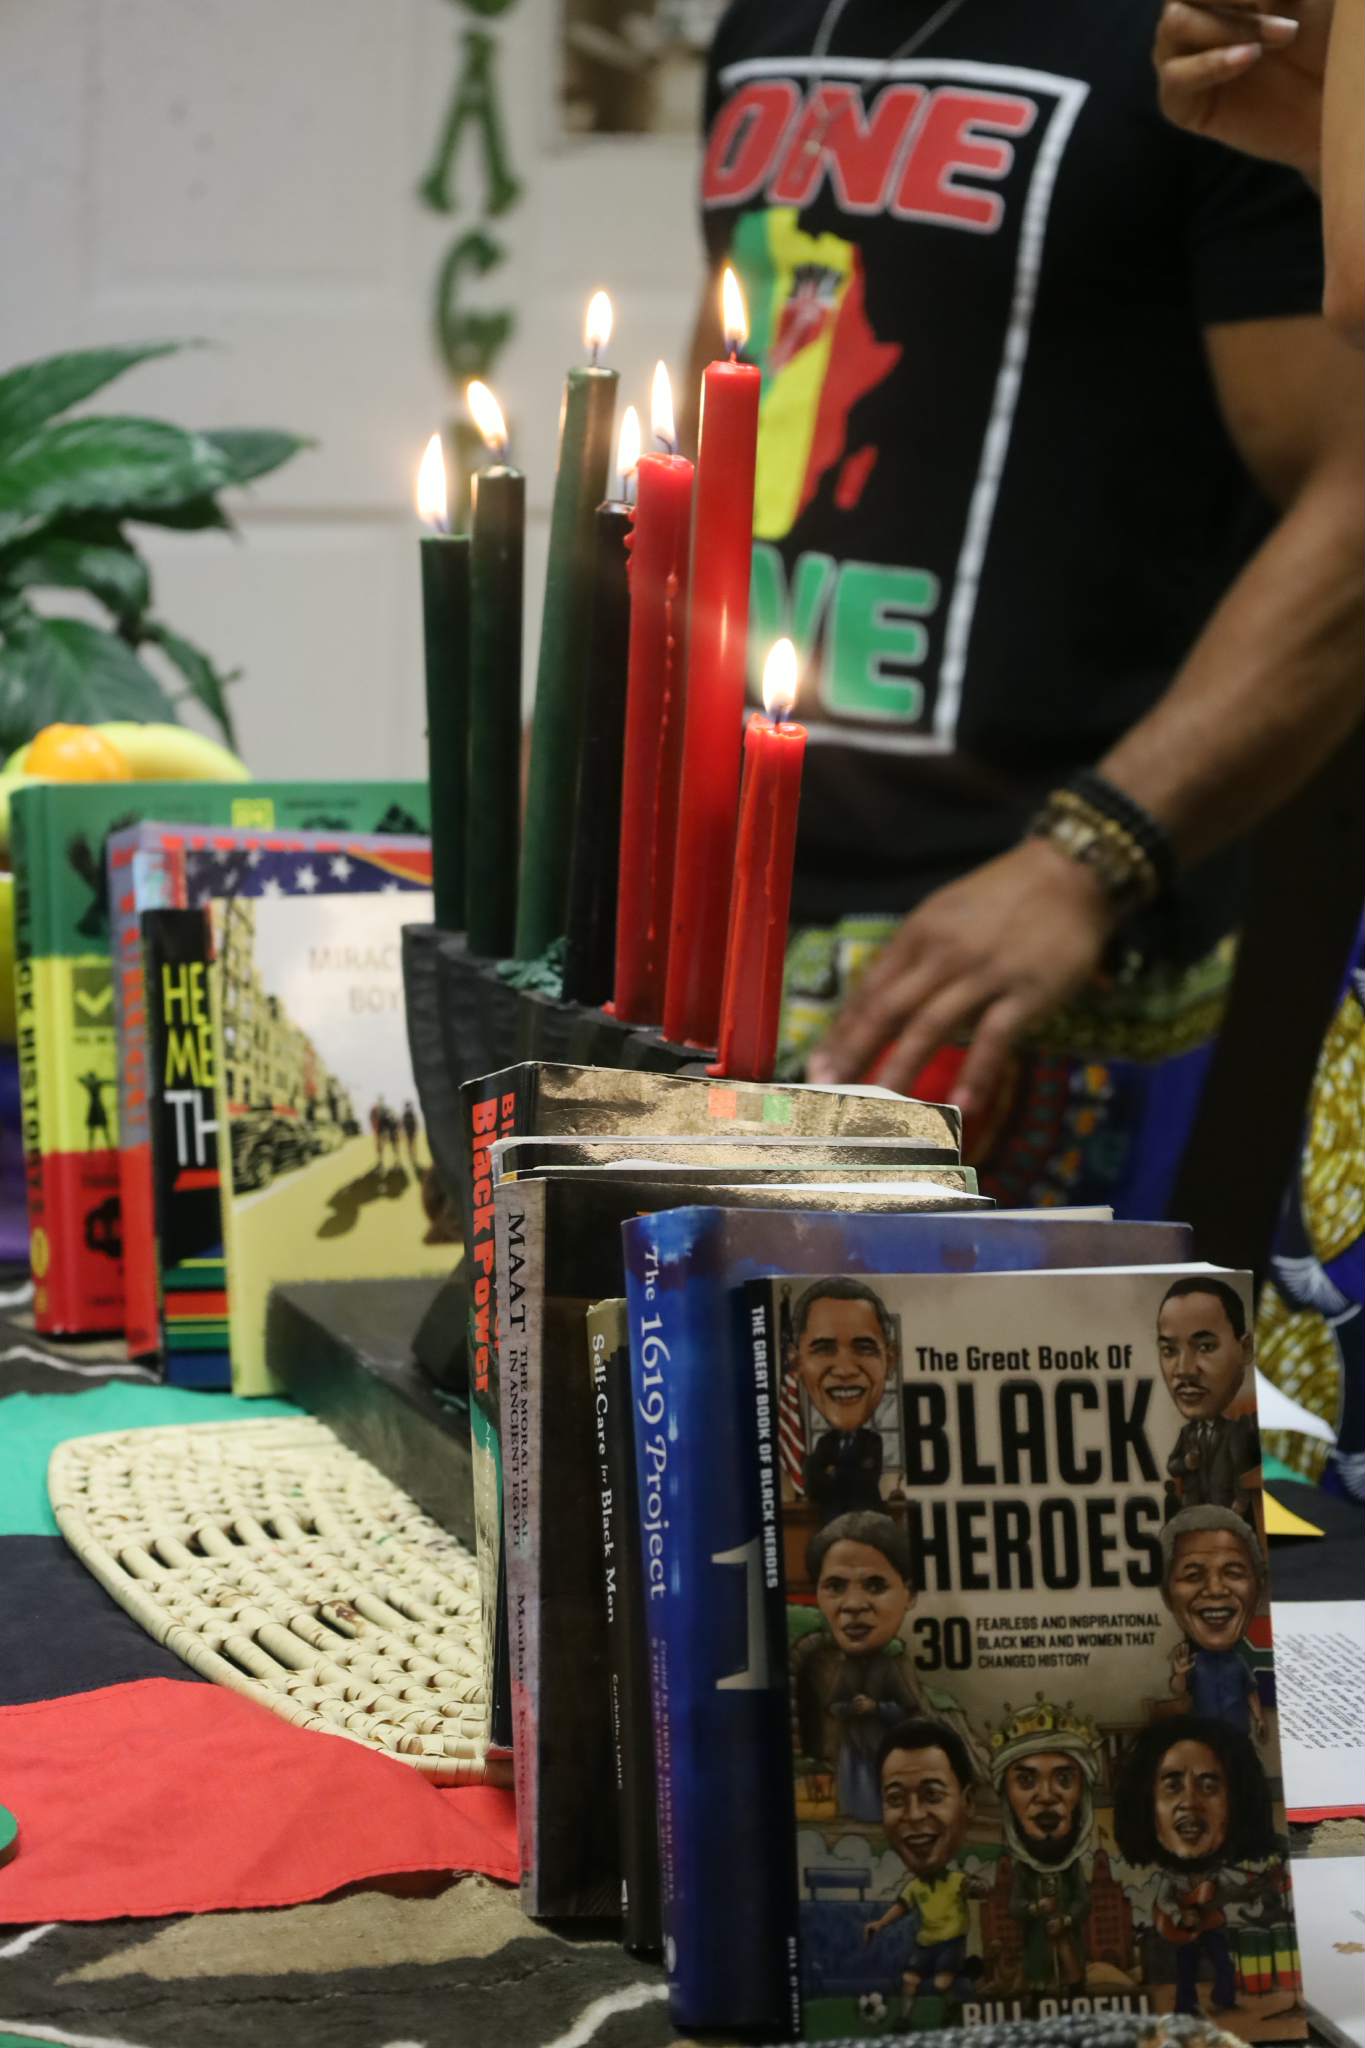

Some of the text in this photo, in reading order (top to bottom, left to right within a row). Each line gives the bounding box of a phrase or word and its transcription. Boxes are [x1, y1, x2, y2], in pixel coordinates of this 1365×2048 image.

[703, 78, 1037, 236] ONE
[473, 1097, 498, 1393] Black Power
[509, 1210, 526, 1333] MAAT
[915, 1345, 1133, 1371] The Great Book Of
[510, 1349, 520, 1551] IN ANCIENT EGYPT
[520, 1346, 529, 1545] THE MORAL IDEAL
[592, 1333, 617, 1624] Self-Care for Black Men
[638, 1244, 671, 1601] The 1619 Project
[752, 1304, 778, 1589] THE GREAT BOOK OF BLACK HEROES
[902, 1378, 1161, 1487] BLACK
[910, 1496, 1164, 1592] HEROES
[913, 1616, 972, 1671] 30
[976, 1614, 1162, 1631] FEARLESS AND INSPIRATIONAL
[976, 1632, 1157, 1650] BLACK MEN AND WOMEN THAT
[977, 1653, 1091, 1669] CHANGED HISTORY
